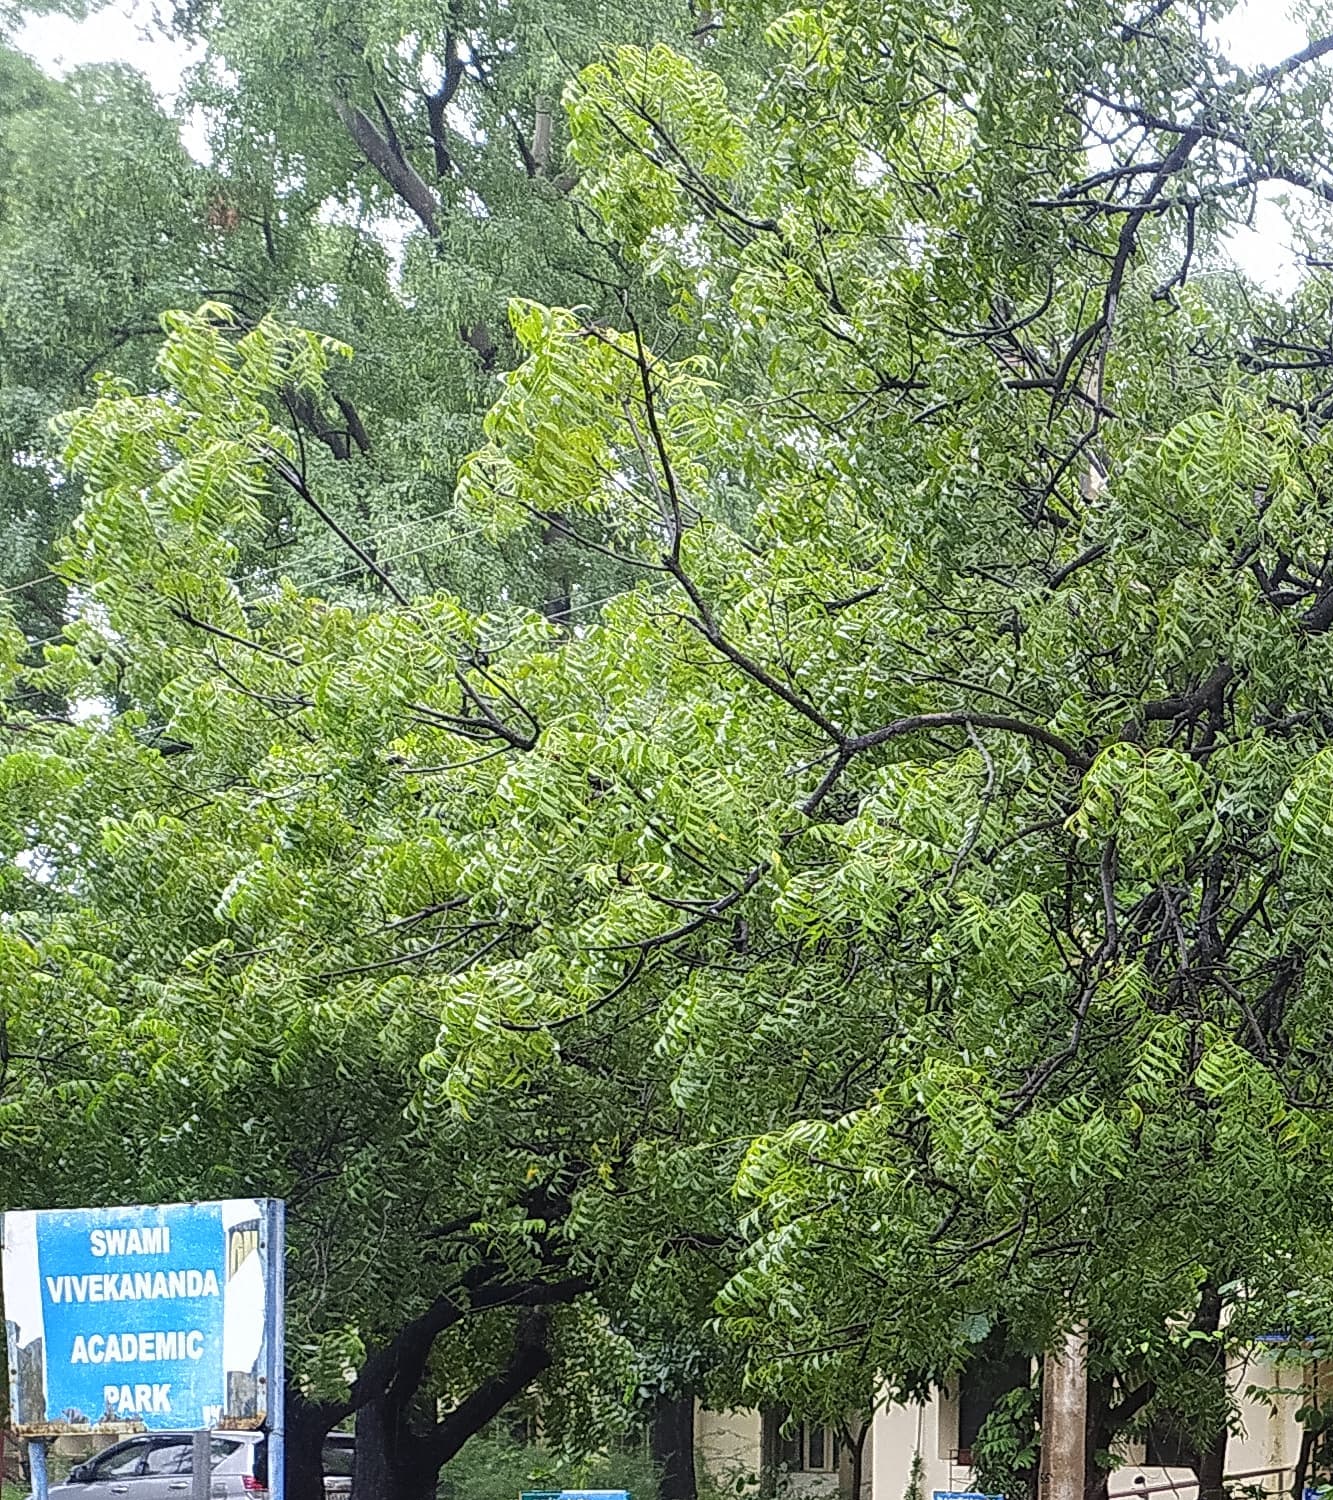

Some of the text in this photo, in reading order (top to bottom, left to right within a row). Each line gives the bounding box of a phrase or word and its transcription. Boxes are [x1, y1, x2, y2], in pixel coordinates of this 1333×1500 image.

[90, 1227, 170, 1257] SWAMI
[46, 1269, 220, 1303] VIVEKANANDA
[71, 1330, 204, 1364] ACADEMIC
[104, 1383, 172, 1413] PARK
